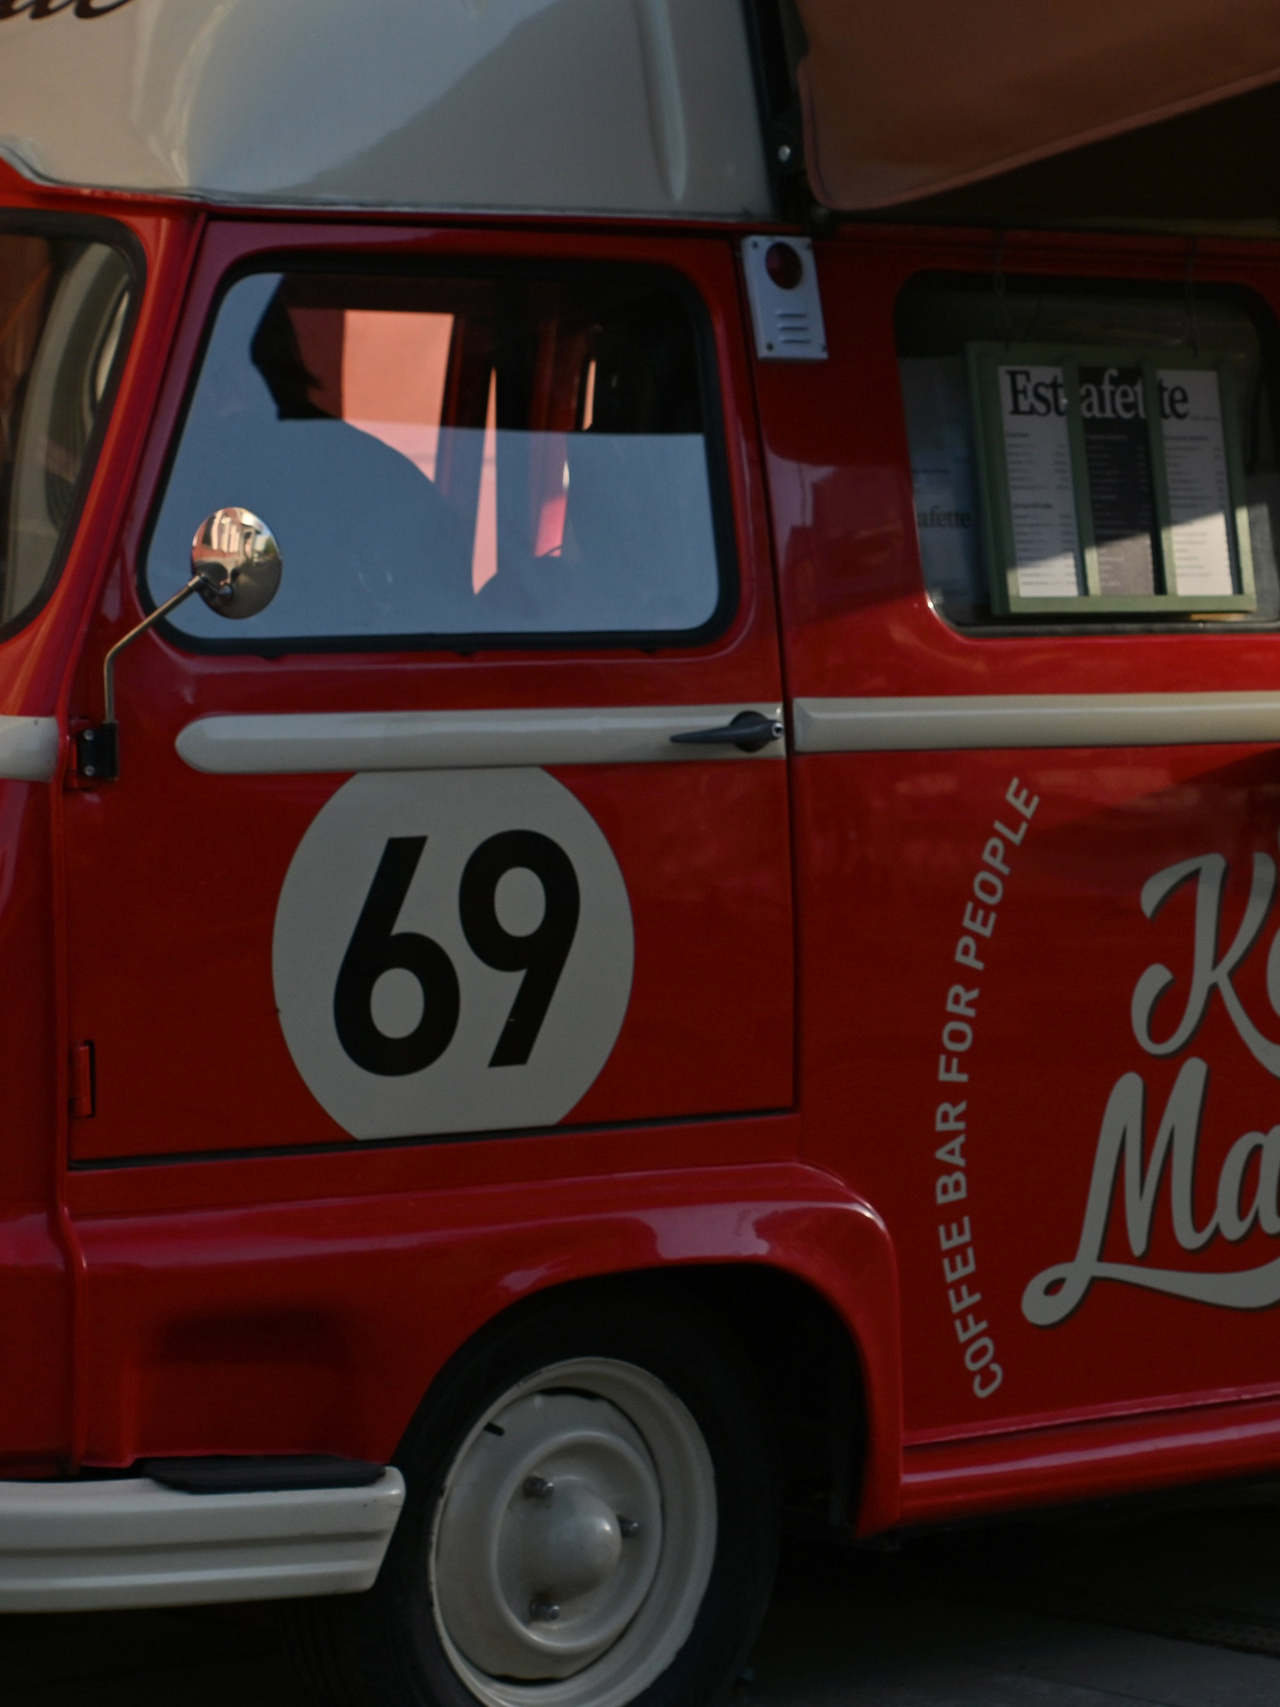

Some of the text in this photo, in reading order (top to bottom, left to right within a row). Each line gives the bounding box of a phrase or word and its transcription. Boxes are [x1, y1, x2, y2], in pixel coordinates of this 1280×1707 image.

[333, 828, 581, 1077] 69
[935, 777, 1041, 1399] COFFEE BAR FOR PEOPLE
